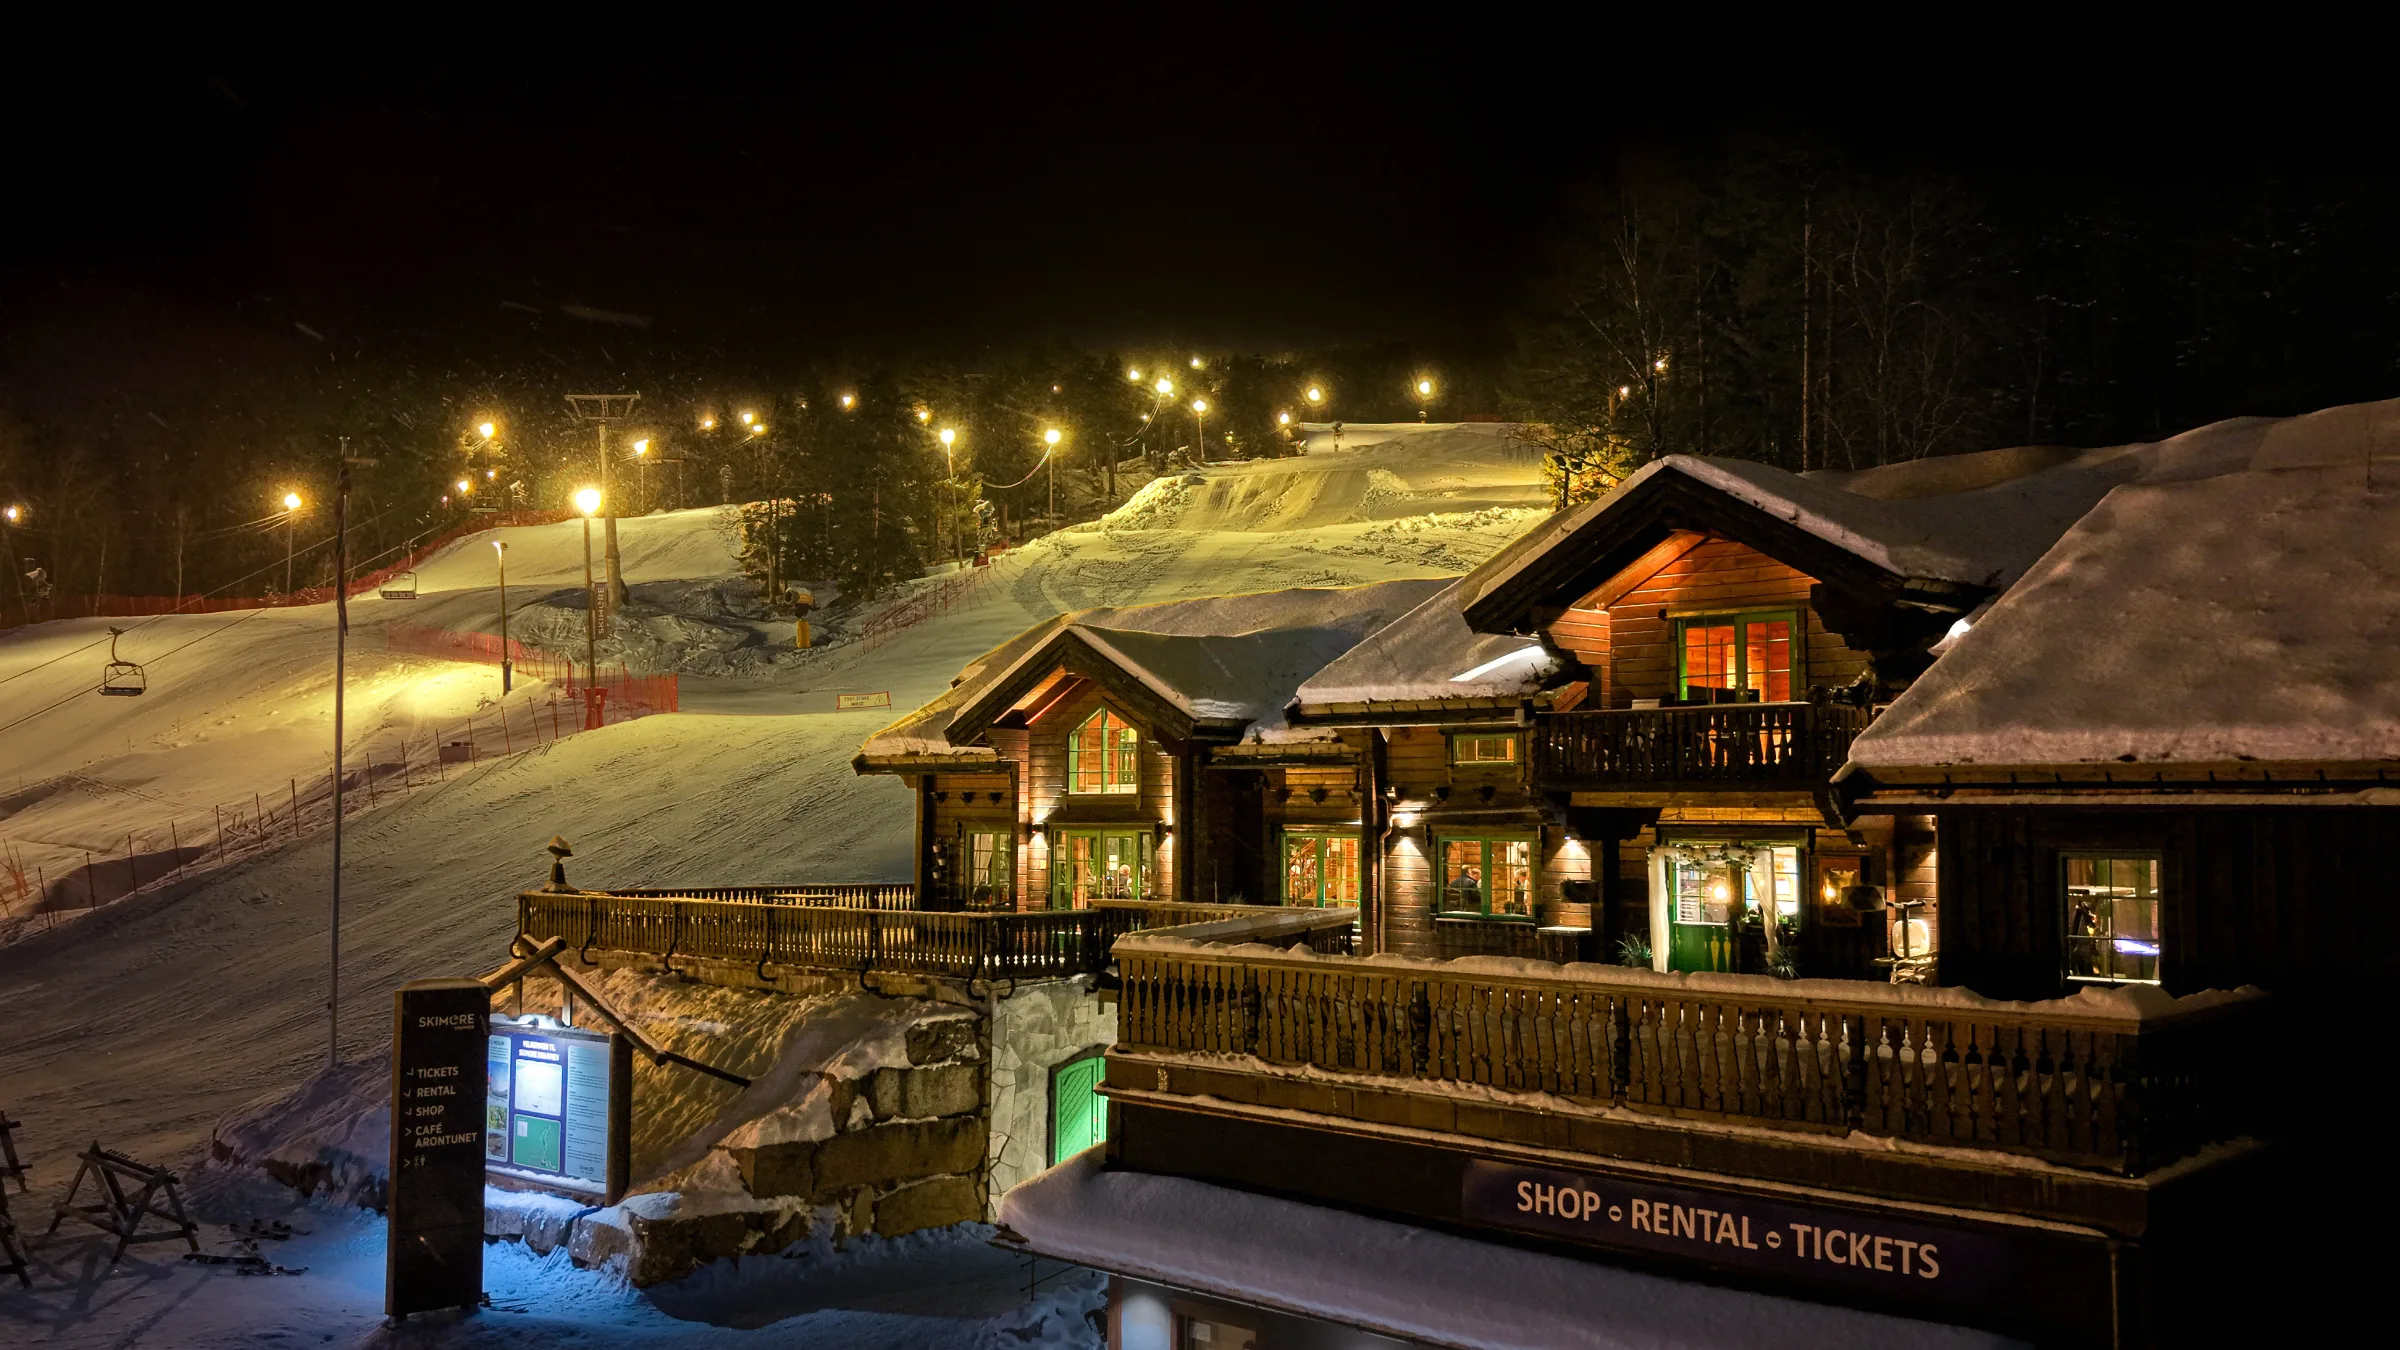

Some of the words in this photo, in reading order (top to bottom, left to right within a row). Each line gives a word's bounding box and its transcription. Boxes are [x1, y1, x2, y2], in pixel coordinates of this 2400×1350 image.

[419, 1013, 475, 1028] SKIMORE
[417, 1066, 459, 1079] TICKETS
[416, 1086, 456, 1098] RENTAL
[415, 1105, 445, 1117] SHOP
[415, 1121, 443, 1136] CAFÉ
[415, 1132, 478, 1148] ARONTUNET
[1516, 1181, 1600, 1222] SHOP
[1631, 1198, 1758, 1251] RENTAL
[1790, 1223, 1940, 1280] TICKETS
